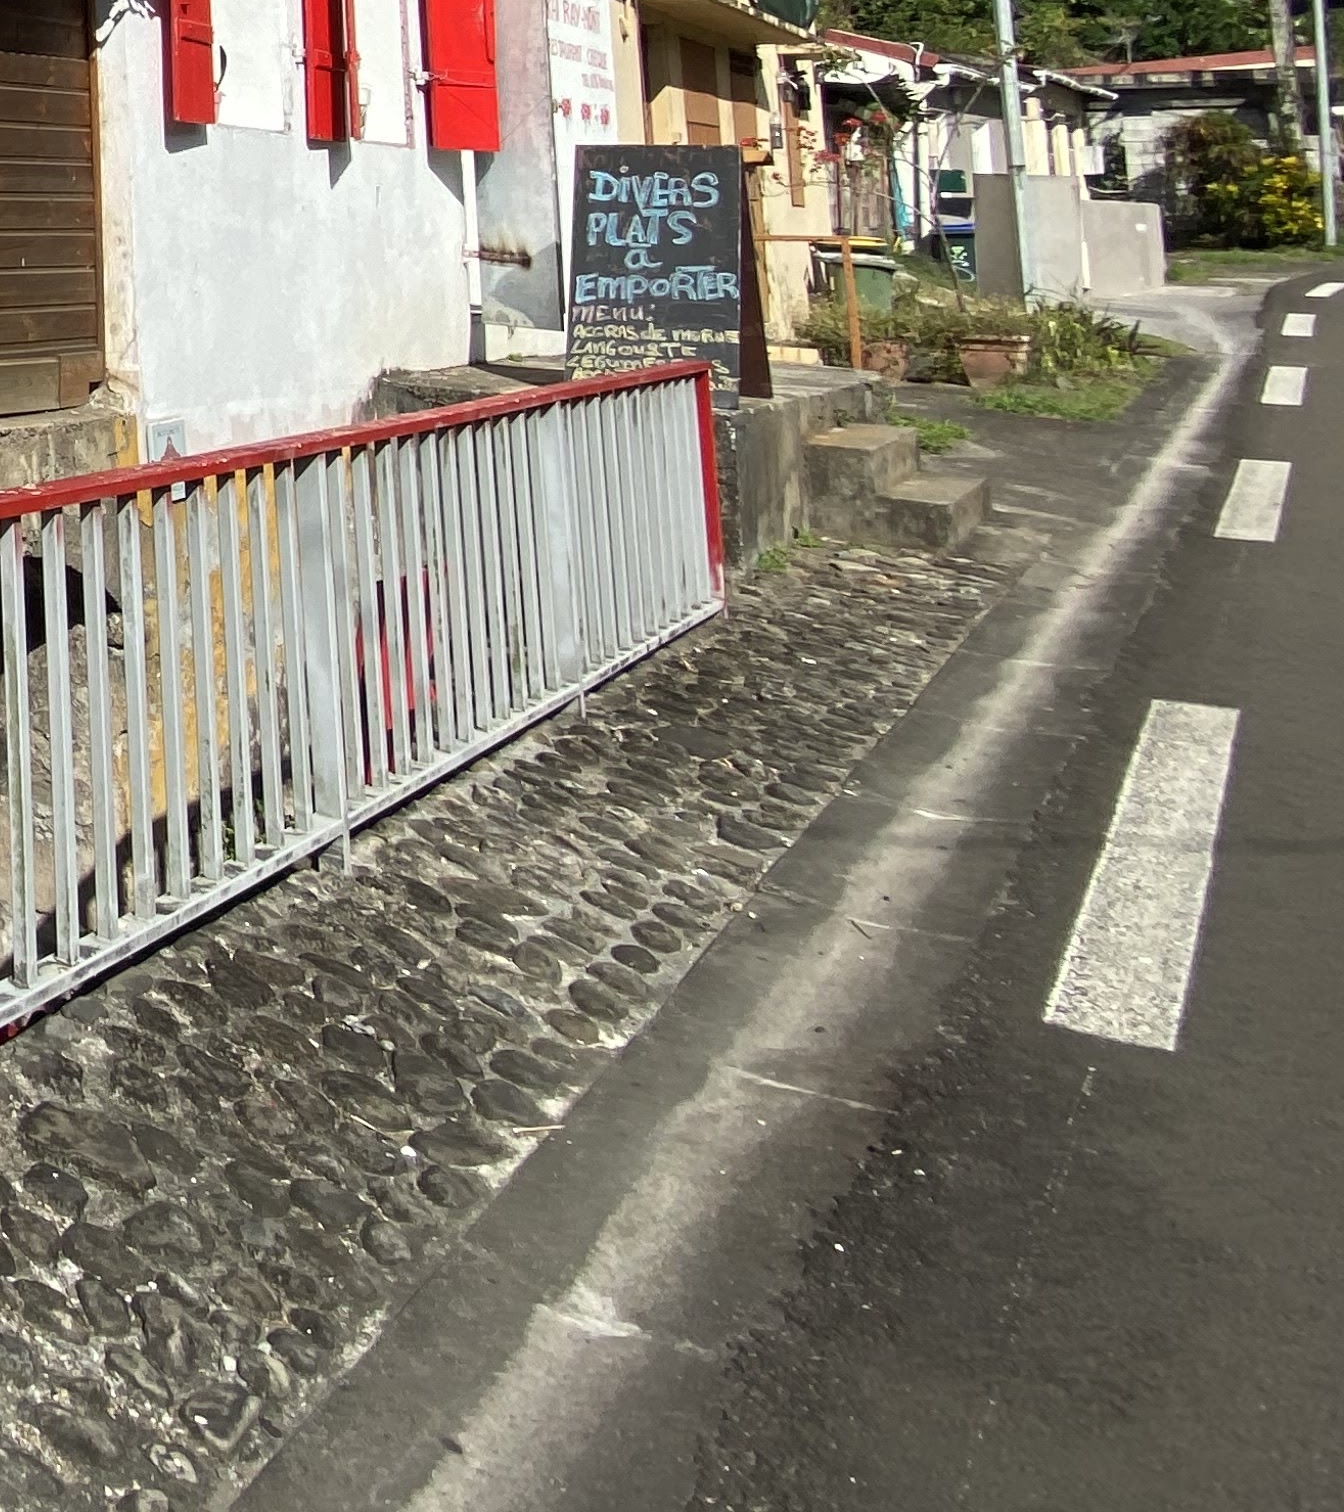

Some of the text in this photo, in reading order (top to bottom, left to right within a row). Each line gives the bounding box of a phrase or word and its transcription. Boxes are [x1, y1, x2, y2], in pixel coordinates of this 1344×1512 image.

[586, 209, 697, 247] PLATS
[575, 265, 740, 304] EMPORTER
[570, 340, 697, 357] LANGOUSTE
